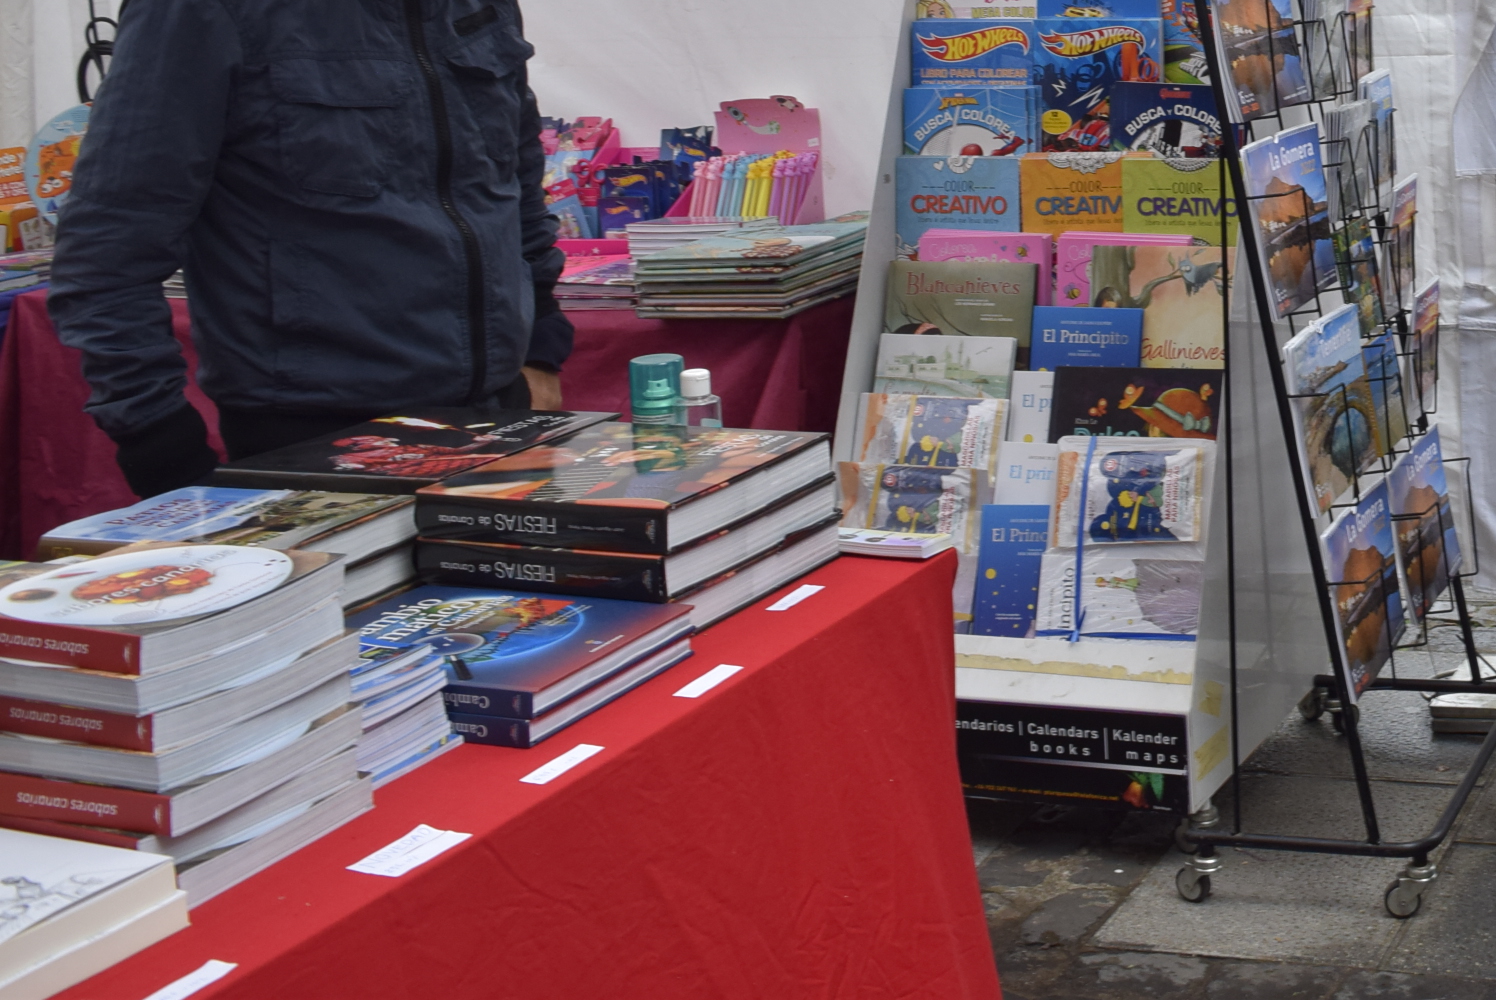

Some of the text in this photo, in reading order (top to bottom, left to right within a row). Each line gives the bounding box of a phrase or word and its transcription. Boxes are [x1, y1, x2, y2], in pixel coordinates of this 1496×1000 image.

[971, 6, 1035, 18] MEGA COLOR
[948, 36, 976, 60] HOT
[1065, 34, 1095, 56] HOT
[921, 68, 1028, 78] LIBRO PARA COLOREAR
[914, 108, 1018, 142] BUSCA COLOREA
[1124, 106, 1166, 136] BUSCA
[1269, 141, 1315, 171] La Gomera
[944, 180, 975, 193] COLOR
[1069, 181, 1102, 194] COLOR
[1171, 182, 1204, 195] COLOR
[909, 195, 1007, 215] CREATIVO
[906, 271, 1021, 296] Blancanieves
[1043, 328, 1129, 348] El Principito
[1022, 394, 1035, 408] El
[1414, 441, 1438, 474] Gomera
[1009, 464, 1022, 480] El
[1164, 468, 1174, 520] MASCARILLAS
[478, 515, 492, 526] de
[494, 513, 557, 535] FIESTAS
[1346, 496, 1385, 543] La Gomera
[992, 527, 1005, 543] El
[478, 563, 492, 574] de
[494, 560, 557, 583] FIESTAS
[44, 639, 90, 656] sabores
[9, 706, 104, 732] sabores canarios
[1026, 722, 1100, 740] Calendars
[1112, 728, 1179, 747] Kalender
[1029, 740, 1091, 757] books
[1125, 749, 1179, 765] maps
[16, 791, 118, 817] sabores canarios
